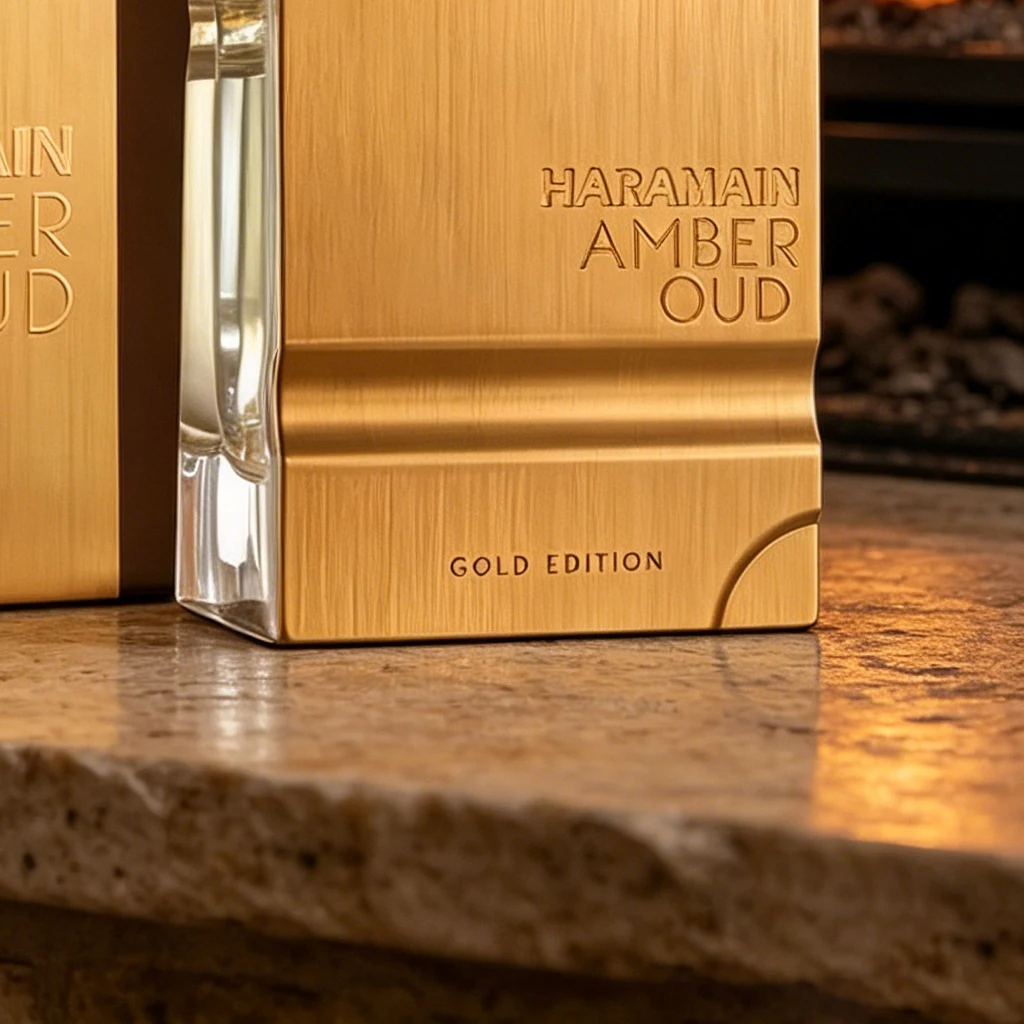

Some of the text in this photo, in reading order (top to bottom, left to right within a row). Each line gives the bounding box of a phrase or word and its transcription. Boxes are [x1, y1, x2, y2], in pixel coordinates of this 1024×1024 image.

[541, 166, 800, 207] HARAMAIN
[580, 217, 799, 269] AMBER
[660, 276, 790, 323] OUD
[450, 551, 663, 576] GOLD EDITION
